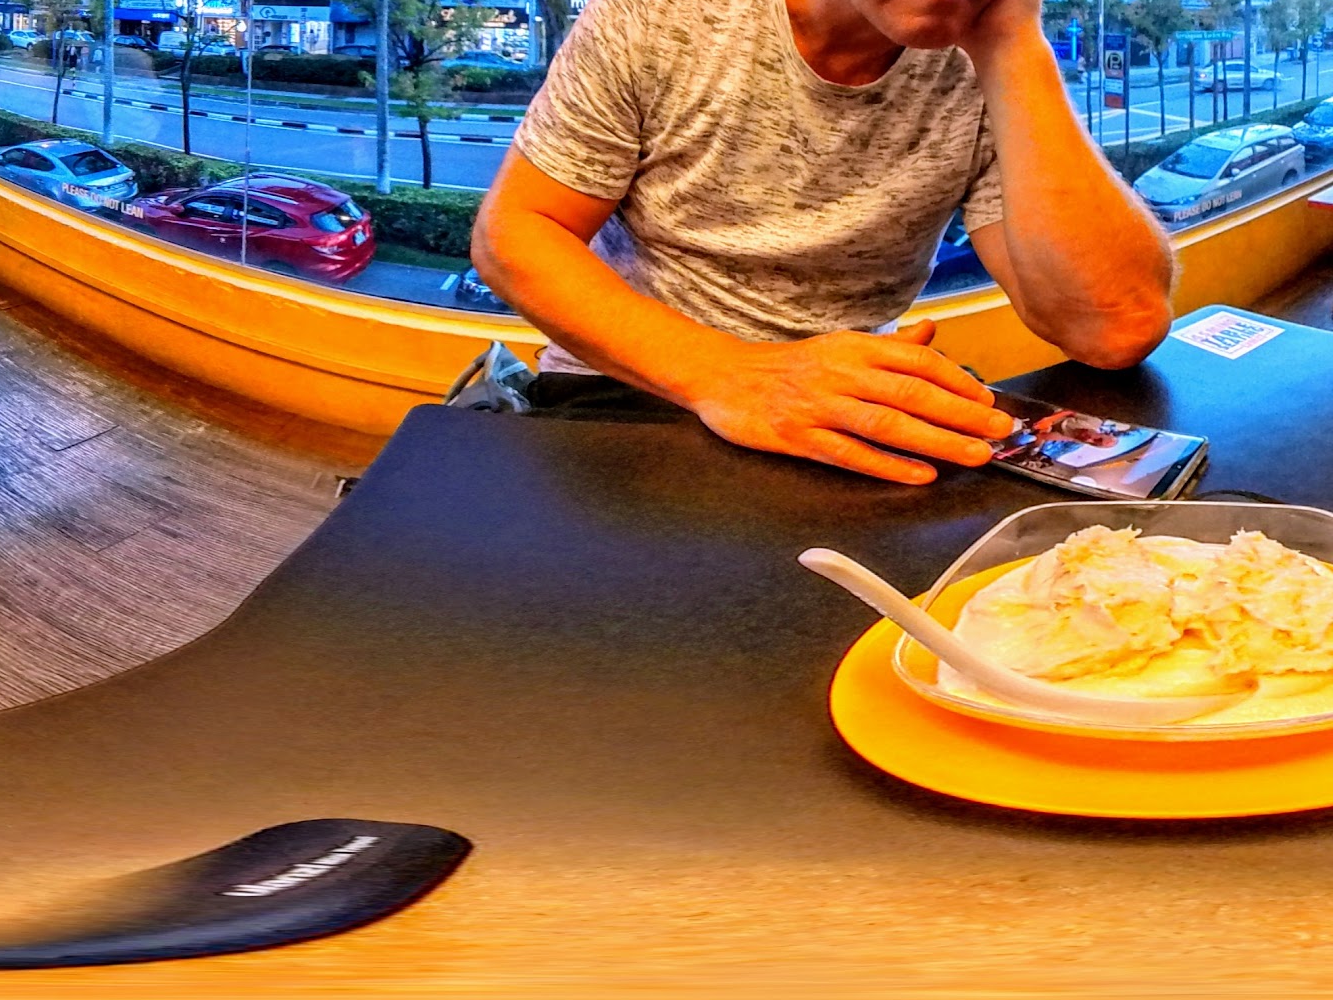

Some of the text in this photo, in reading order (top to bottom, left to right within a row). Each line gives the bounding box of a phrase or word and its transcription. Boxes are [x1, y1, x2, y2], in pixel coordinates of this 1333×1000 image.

[61, 182, 144, 219] PLEASE DO NOT LEAN
